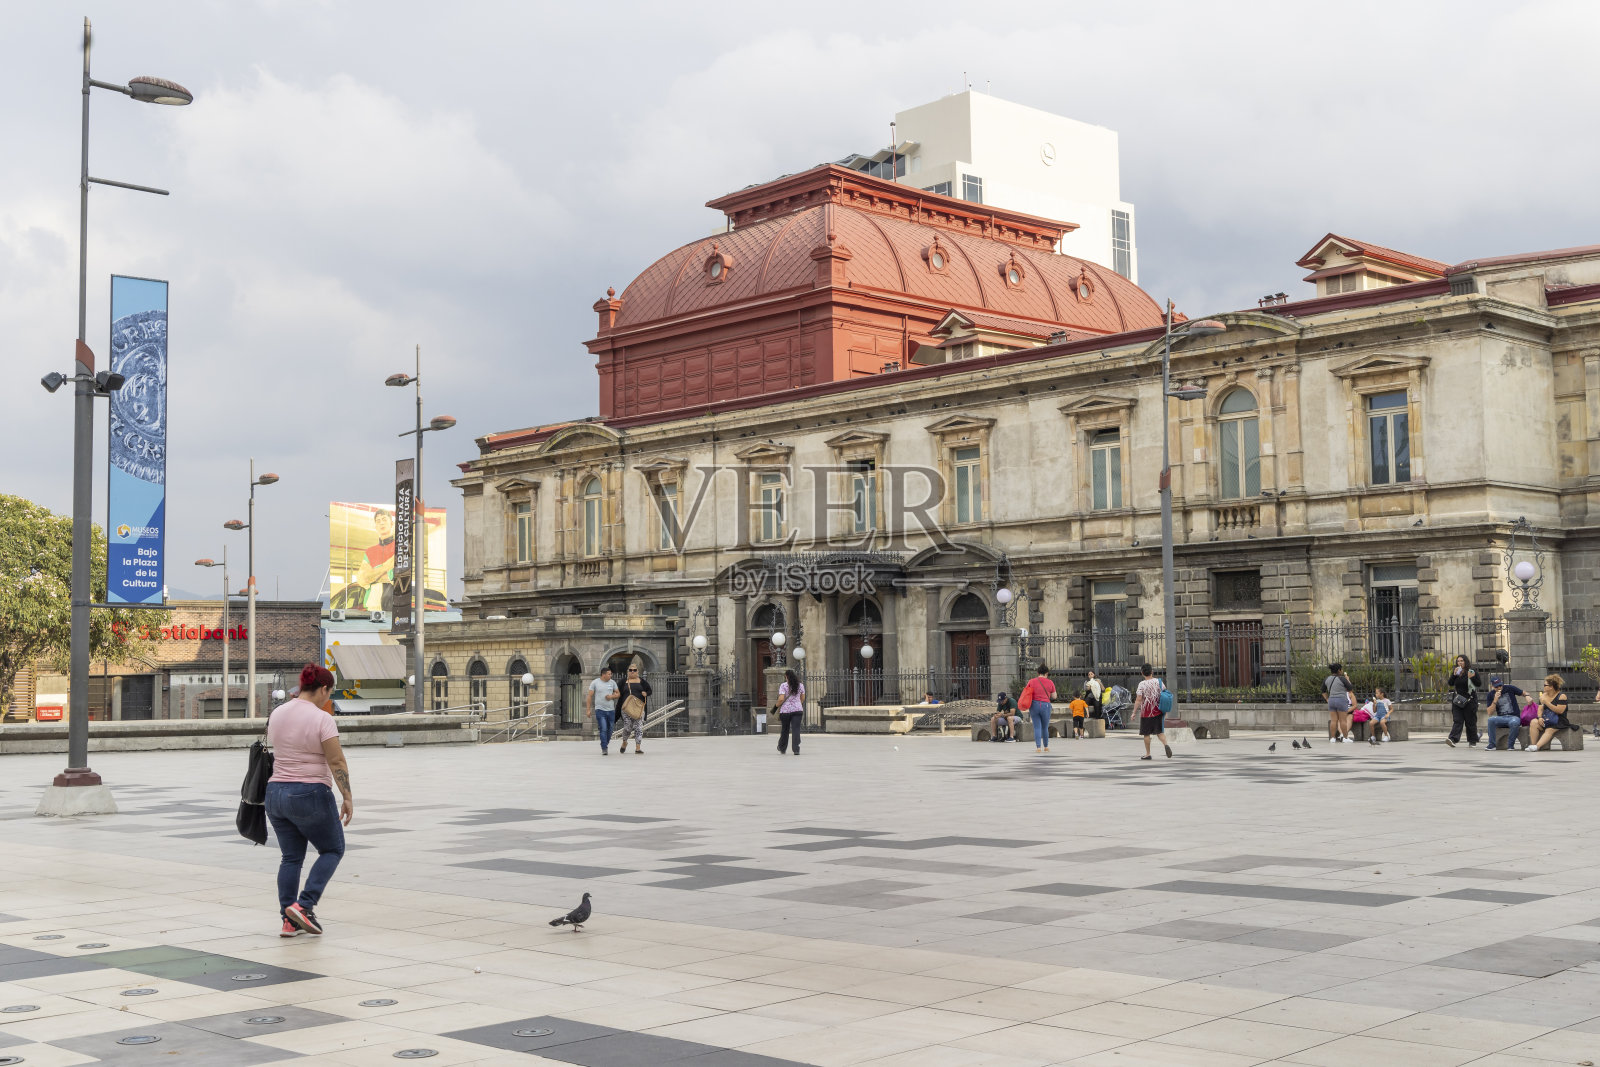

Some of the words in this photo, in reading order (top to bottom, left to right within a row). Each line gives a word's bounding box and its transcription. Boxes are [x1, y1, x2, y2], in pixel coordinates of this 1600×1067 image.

[132, 526, 159, 534] MUSEOS
[404, 540, 409, 552] LA
[138, 548, 158, 558] Bajo
[122, 558, 131, 566] la
[133, 558, 158, 567] Plaza
[404, 554, 408, 568] DE
[135, 569, 147, 577] de
[148, 569, 157, 577] la
[122, 579, 157, 588] Cultura
